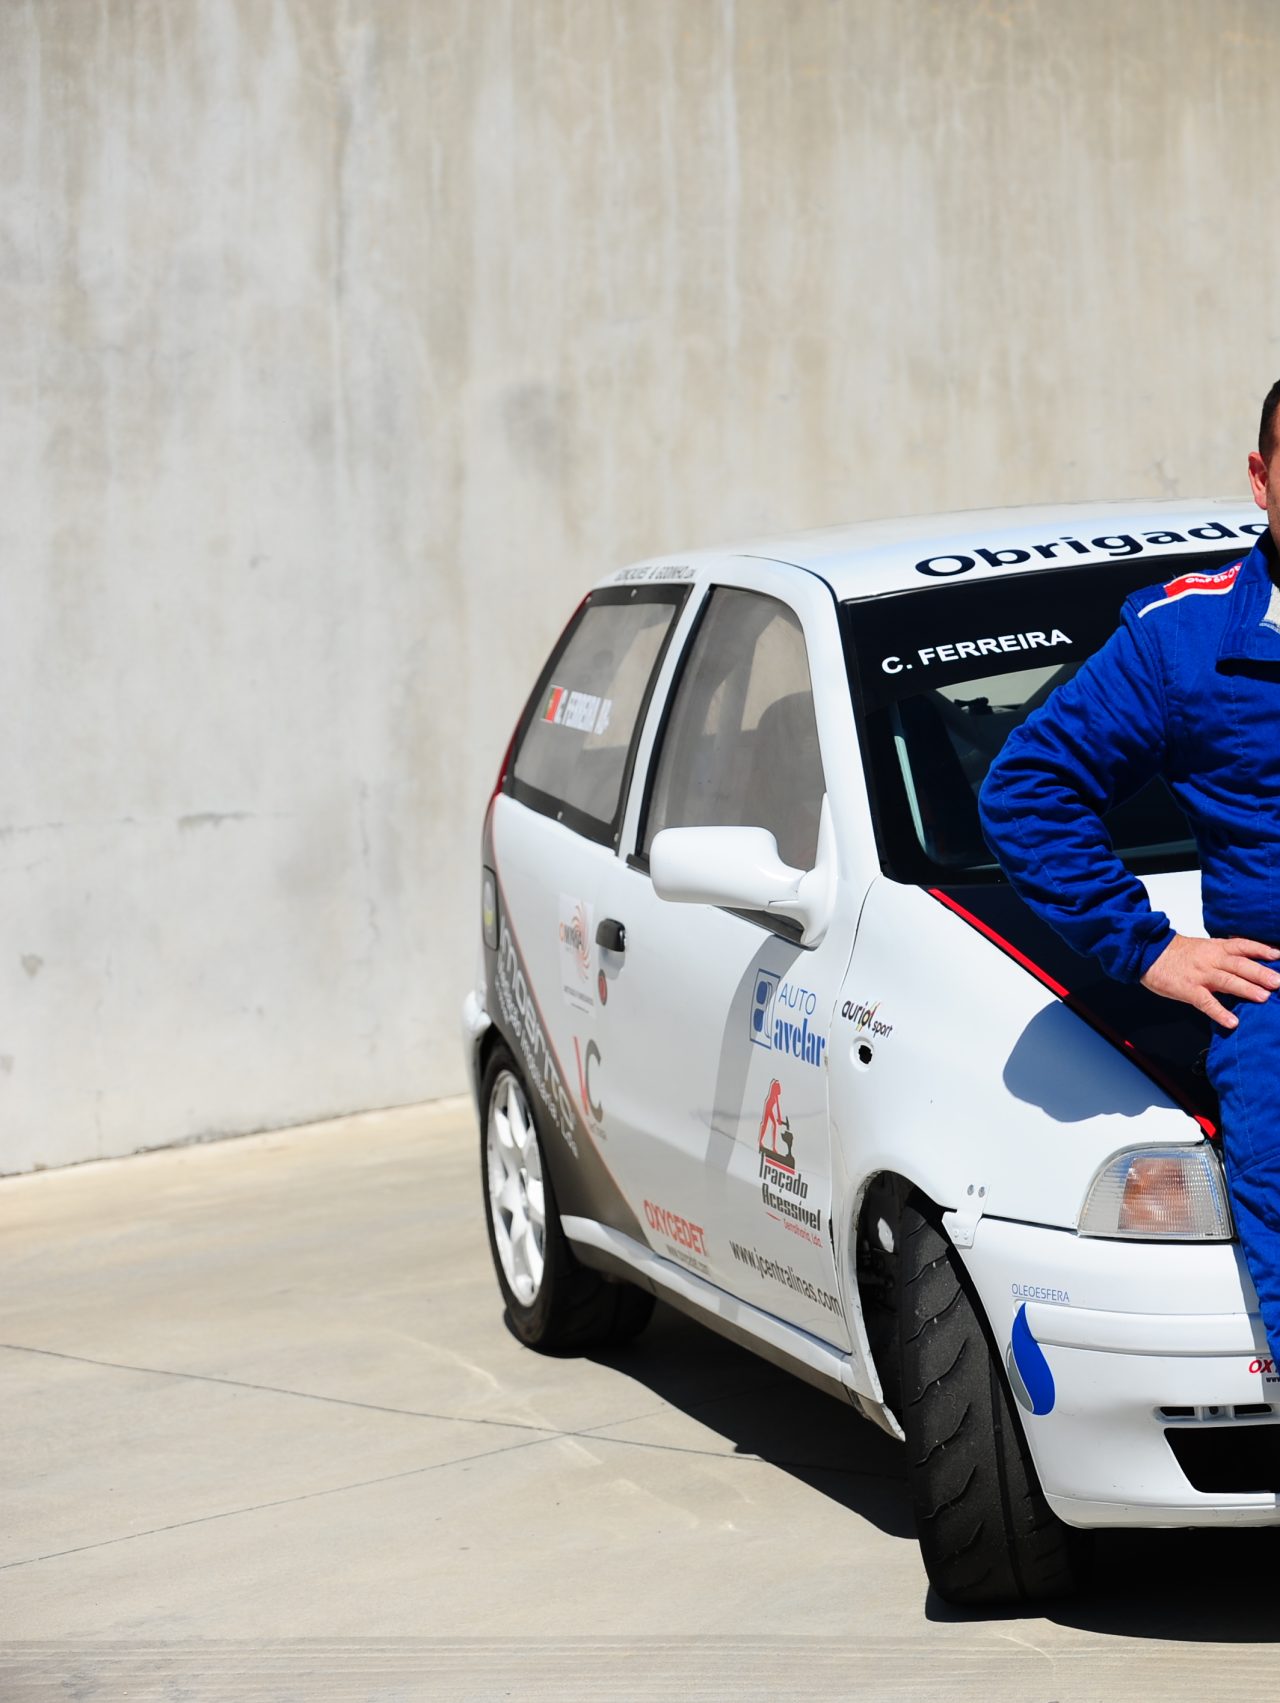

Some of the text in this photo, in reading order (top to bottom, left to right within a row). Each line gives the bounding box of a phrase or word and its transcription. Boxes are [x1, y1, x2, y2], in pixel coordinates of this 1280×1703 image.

[914, 522, 1269, 577] Obrigado
[881, 628, 1072, 675] C. FERREIRA
[778, 983, 817, 1015] AUTO
[841, 1000, 894, 1038] auriol sport
[774, 1018, 826, 1067] avelar
[759, 1151, 809, 1199] Traçado
[762, 1182, 821, 1232] Acessível
[729, 1239, 844, 1318] www.jcentralinas.com
[1011, 1283, 1070, 1302] OLEOESFERA
